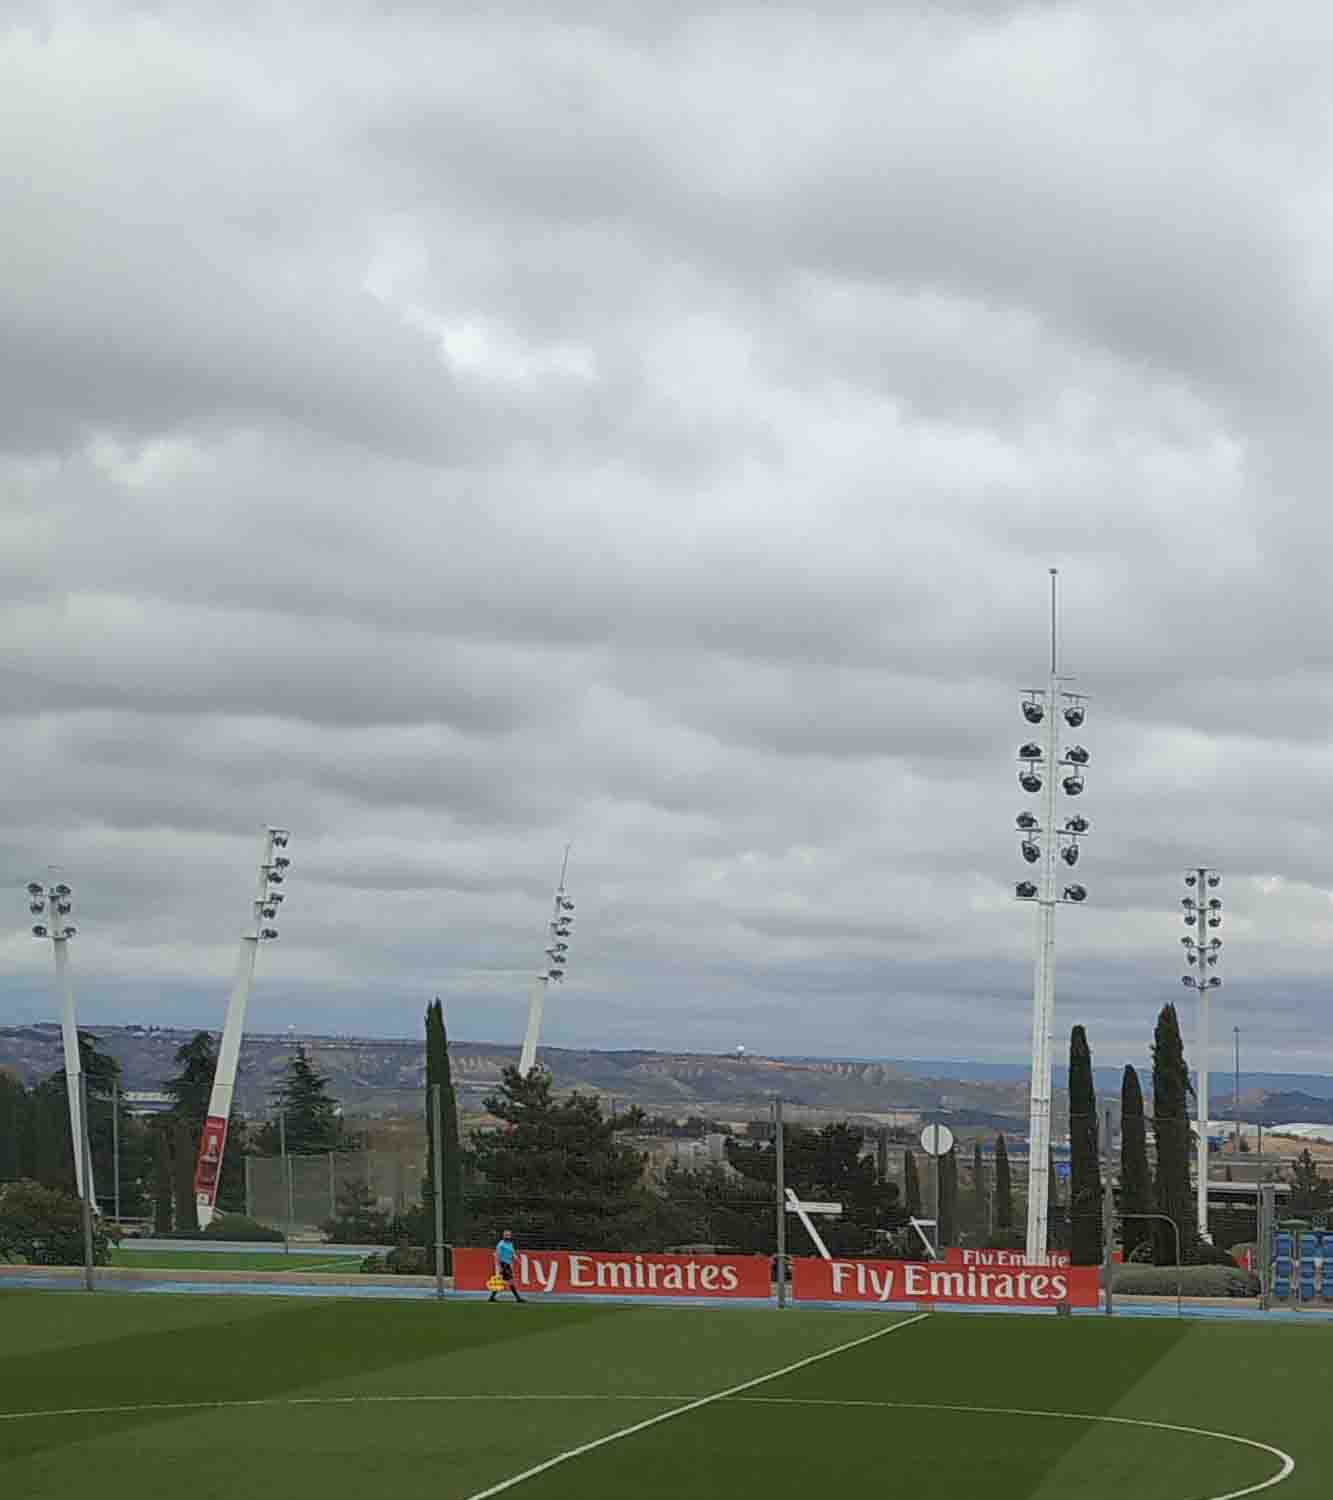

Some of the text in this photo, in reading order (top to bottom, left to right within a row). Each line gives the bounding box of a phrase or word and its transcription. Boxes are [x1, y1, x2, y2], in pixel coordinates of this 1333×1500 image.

[497, 1252, 738, 1292] ly Emirates
[831, 1262, 1068, 1301] Fly Emirates
